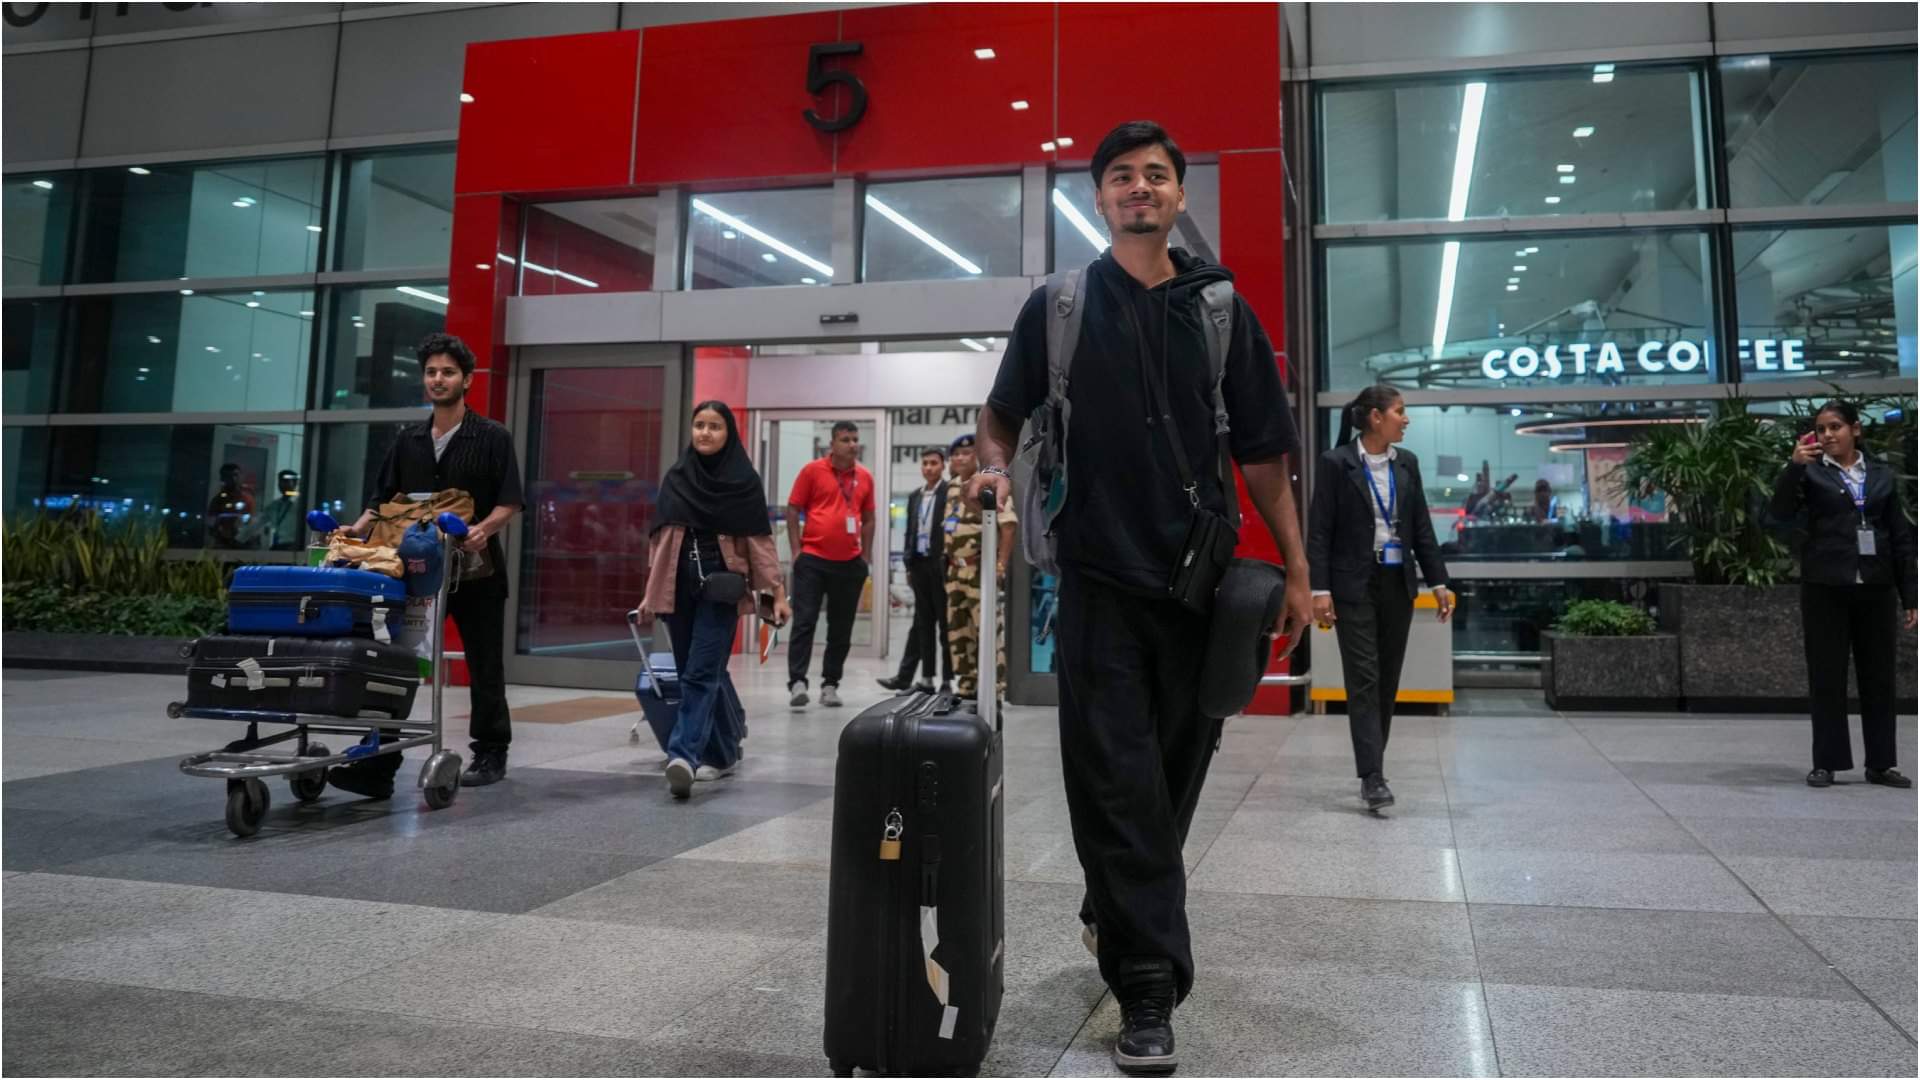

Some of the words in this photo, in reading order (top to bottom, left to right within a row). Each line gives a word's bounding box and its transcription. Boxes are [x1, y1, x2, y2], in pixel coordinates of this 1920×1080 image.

[803, 42, 868, 132] 5
[1482, 342, 1624, 379] COSTA
[1637, 339, 1805, 373] COEE
